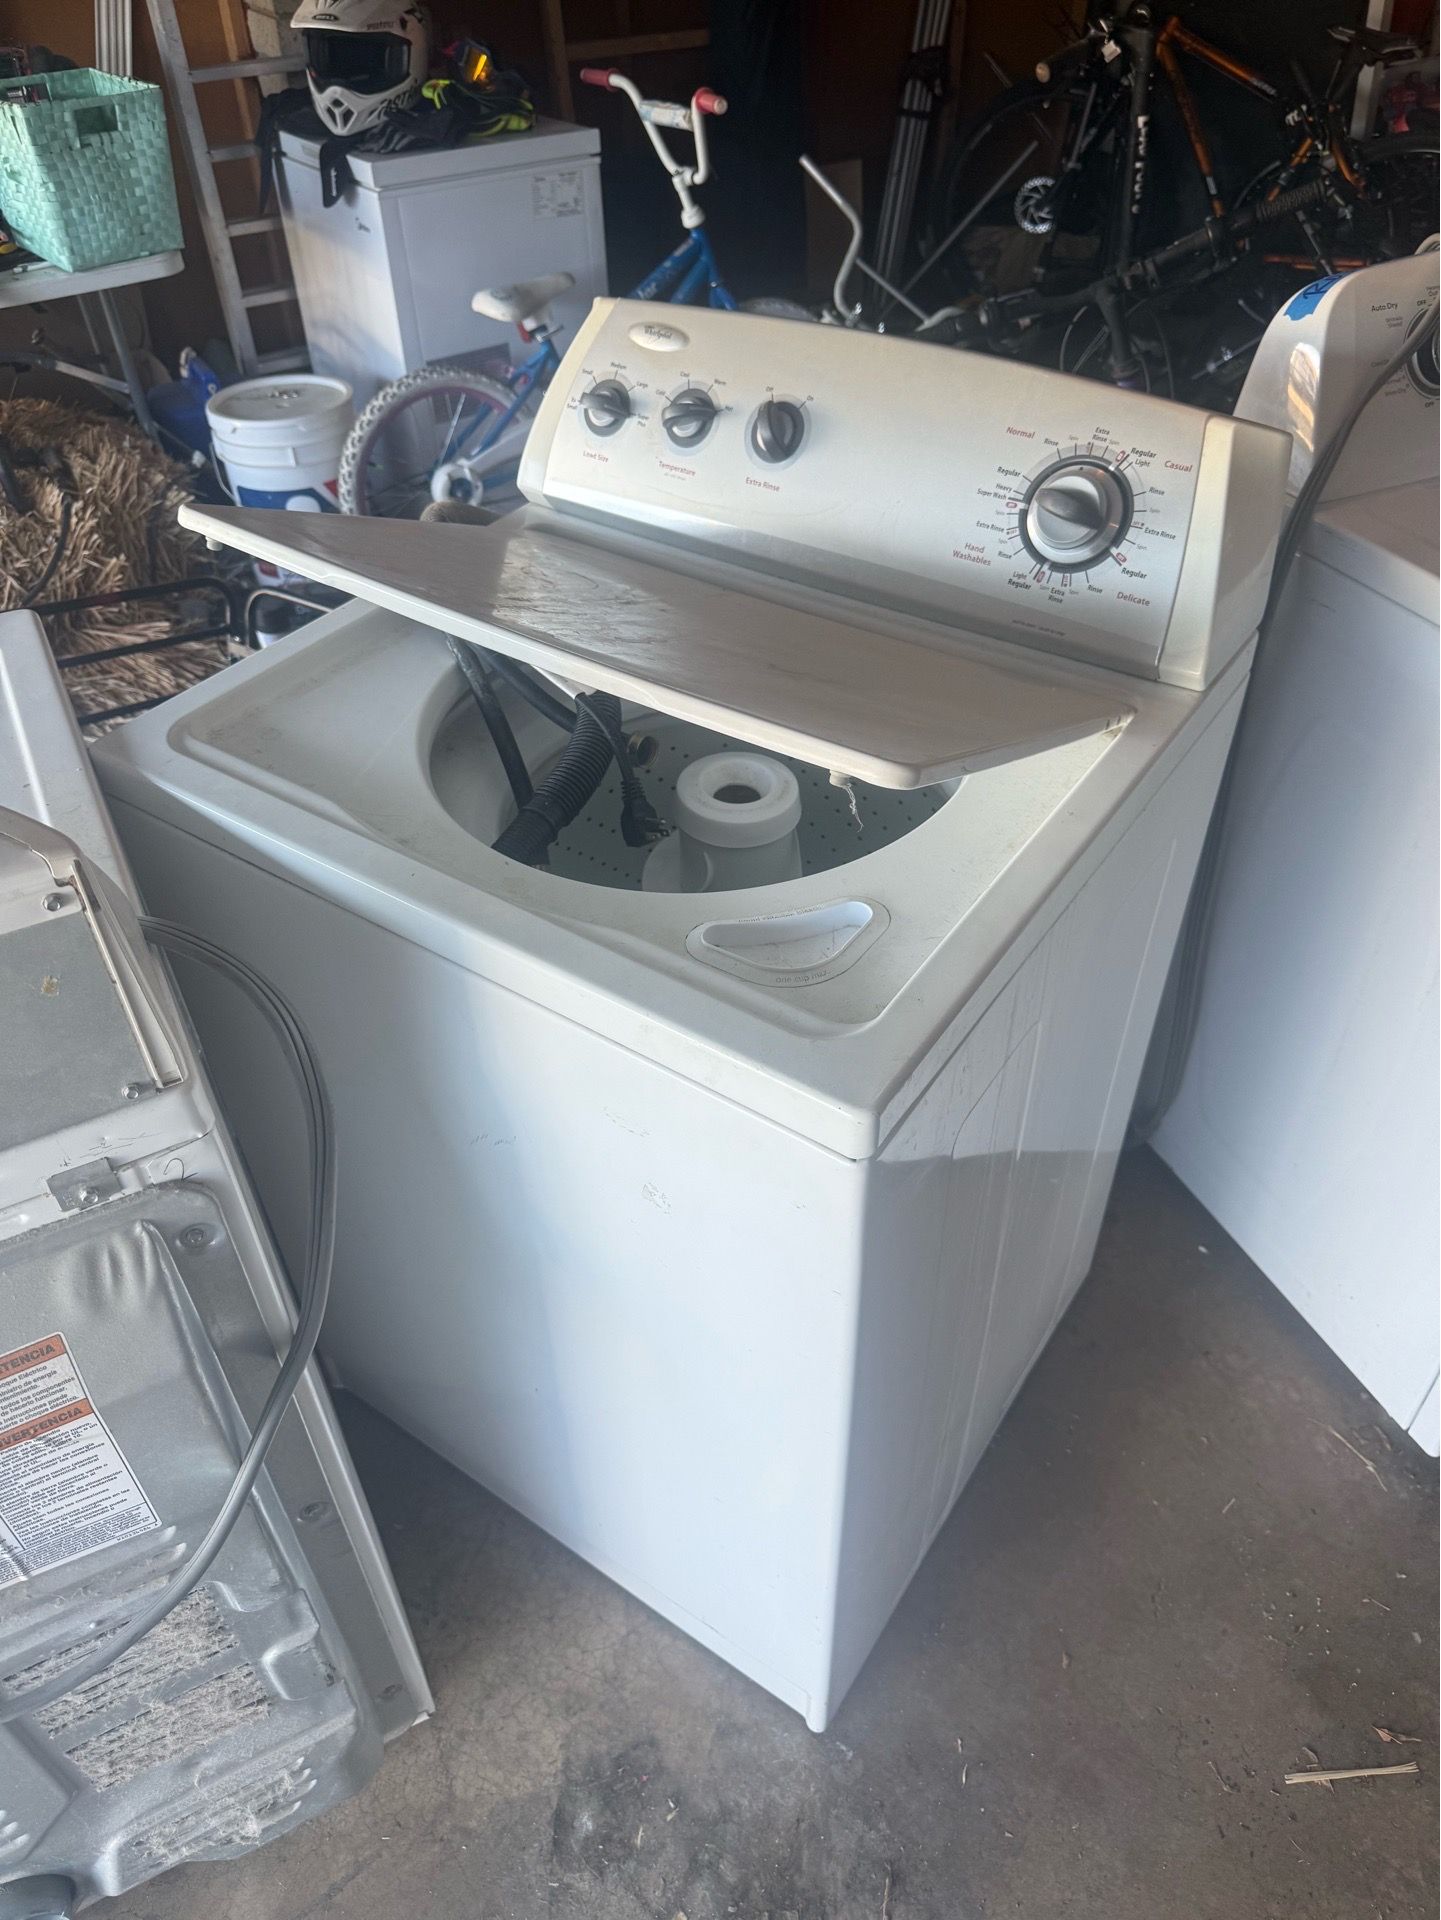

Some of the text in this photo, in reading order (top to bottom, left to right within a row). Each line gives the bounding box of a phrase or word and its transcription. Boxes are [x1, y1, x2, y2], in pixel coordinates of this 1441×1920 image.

[1006, 426, 1036, 439] Normal
[1095, 427, 1110, 436] Extra
[1044, 438, 1059, 446] Rinse
[1092, 434, 1108, 442] Rinse
[583, 450, 609, 463] Load Size
[1130, 447, 1158, 459] Regular
[658, 460, 696, 476] Temperature
[1134, 458, 1151, 468] Light
[1164, 460, 1193, 472] Casual
[997, 466, 1021, 478] Regular
[746, 477, 780, 492] Extra Rinse
[996, 483, 1012, 493] Heavy
[976, 488, 1007, 500] Super Wash
[1148, 486, 1165, 496] Rinse
[976, 520, 990, 530] Extra
[990, 524, 1004, 533] Rinse
[1144, 527, 1176, 540] Extra Rinse
[964, 542, 986, 554] Hand
[952, 550, 992, 566] Washables
[998, 550, 1012, 560] Rinse
[1013, 571, 1028, 580] Light
[1121, 567, 1148, 580] Regular
[1008, 578, 1032, 590] Regular
[1087, 584, 1102, 594] Rinse
[1050, 587, 1065, 596] Extra
[1116, 592, 1150, 607] Delicate
[18, 1365, 48, 1380] Eléctrico
[32, 1376, 76, 1398] componentes
